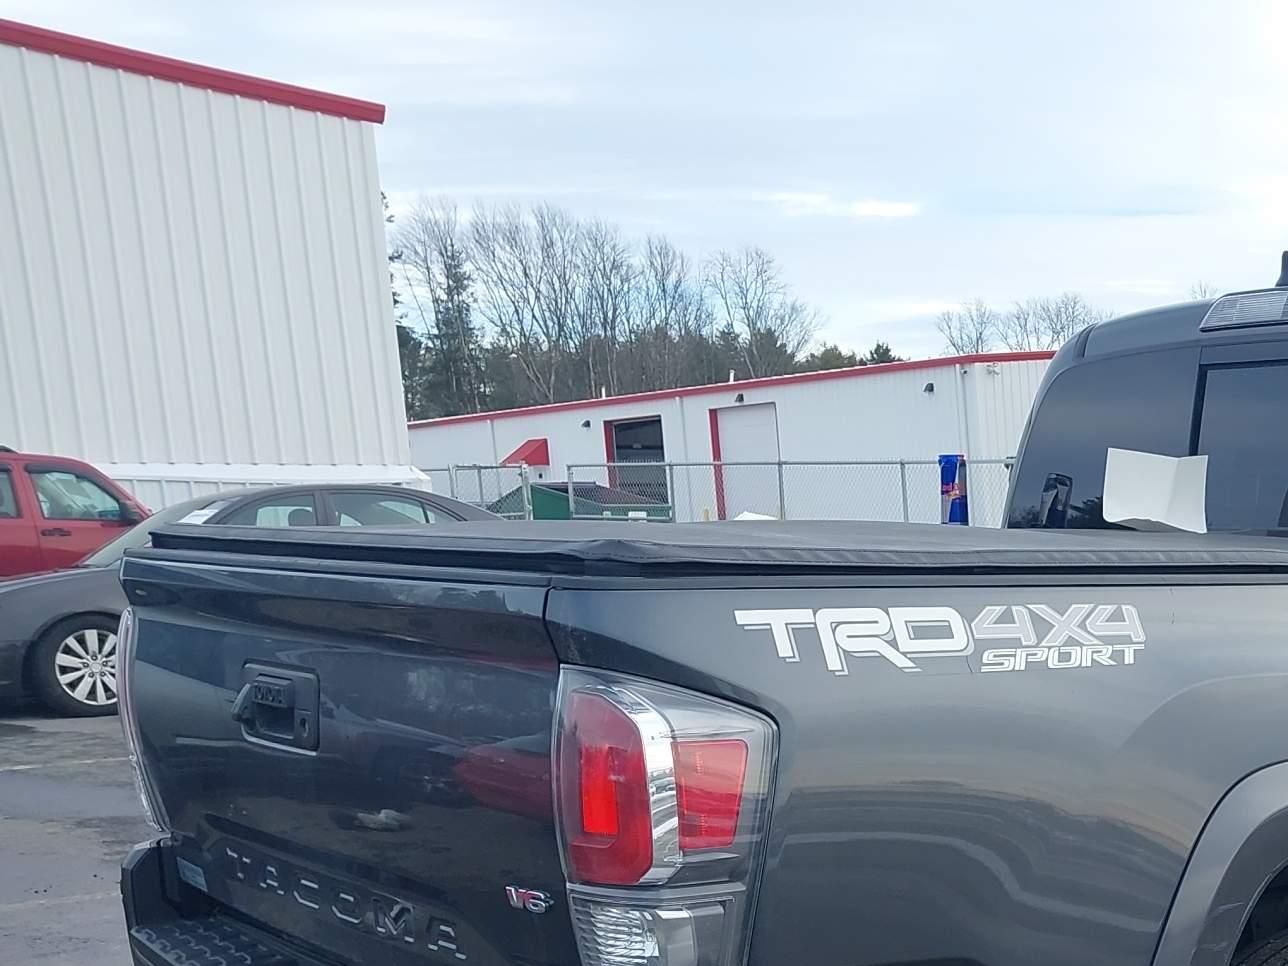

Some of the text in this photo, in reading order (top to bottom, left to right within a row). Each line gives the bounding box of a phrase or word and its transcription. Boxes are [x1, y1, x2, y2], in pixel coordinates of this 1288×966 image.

[733, 603, 1147, 676] TRD 4X4
[979, 643, 1146, 674] SPORT
[226, 847, 467, 960] TACOMA
[504, 885, 548, 914] V6
